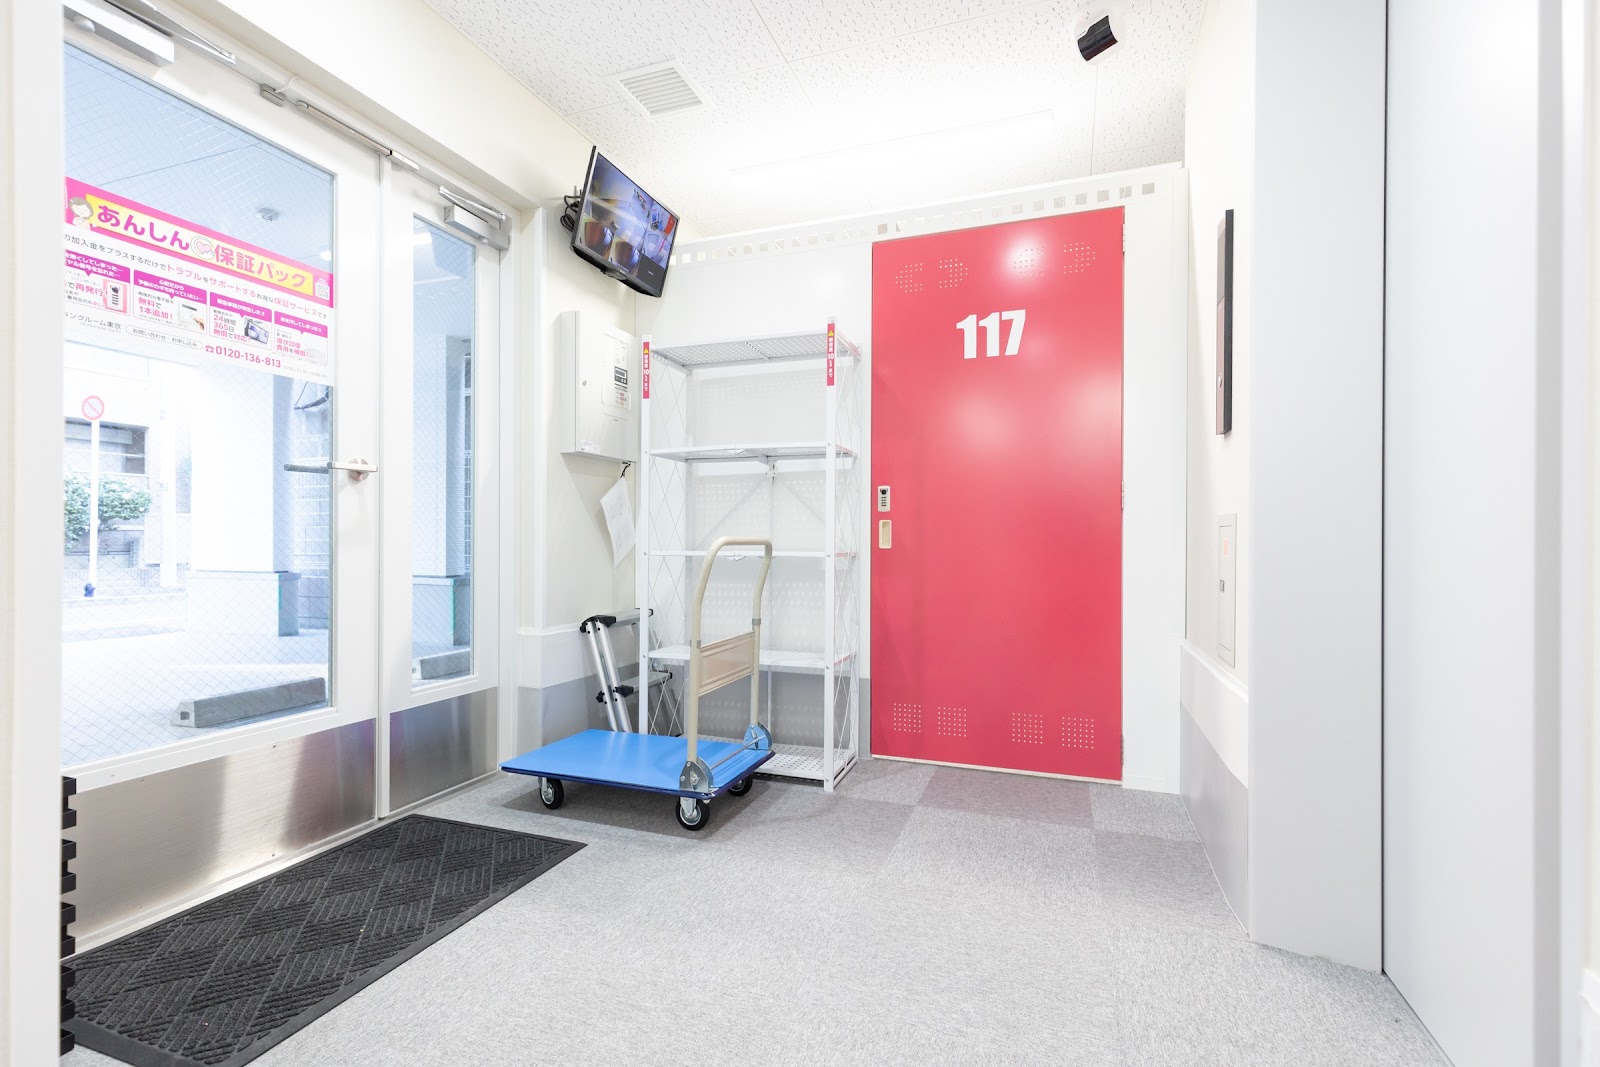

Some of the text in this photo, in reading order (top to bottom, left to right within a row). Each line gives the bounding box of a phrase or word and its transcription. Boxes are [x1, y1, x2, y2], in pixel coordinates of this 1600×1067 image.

[97, 205, 306, 287] あんしん 保証パック
[215, 345, 282, 369] 0120-136-813
[956, 309, 1026, 360] 117
